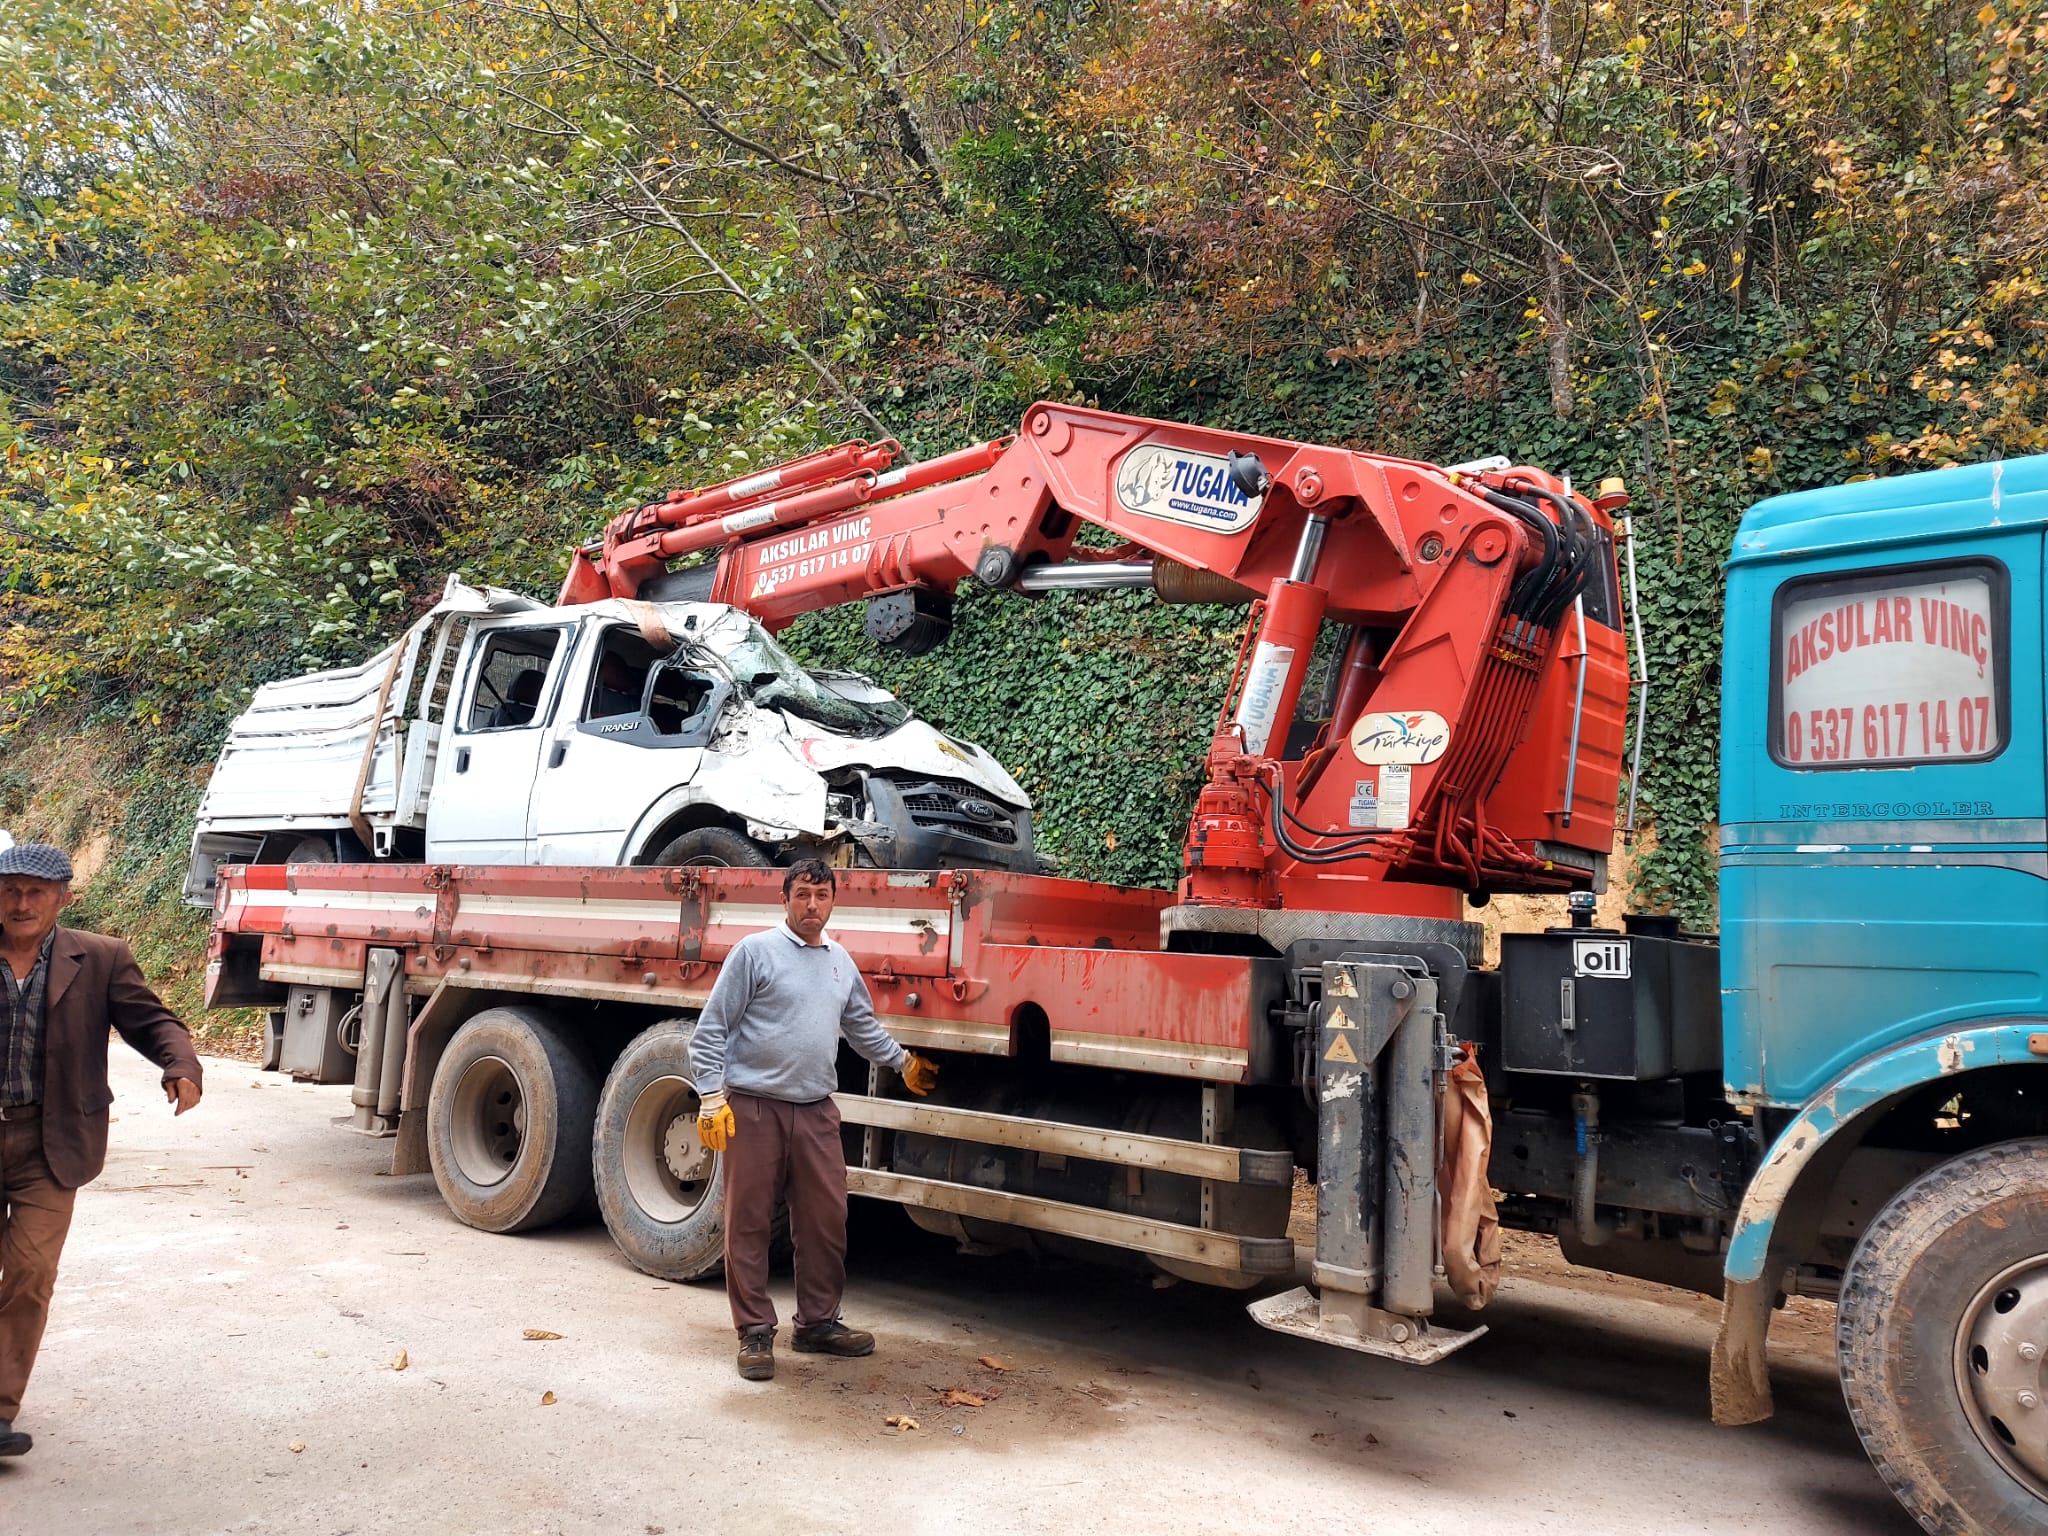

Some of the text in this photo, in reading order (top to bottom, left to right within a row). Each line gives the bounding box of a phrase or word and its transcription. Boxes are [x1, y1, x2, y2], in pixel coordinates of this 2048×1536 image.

[1171, 500, 1236, 521] www.tugana.com
[759, 517, 872, 566] AKSULAR VİNÇ
[759, 542, 871, 588] 0 537 617 14 07
[1786, 595, 1913, 685] AKSULAR
[600, 721, 641, 734] TRANSIT
[1788, 696, 1990, 761] 0 537 617 14 07
[1358, 730, 1443, 762] Türkiye
[1358, 785, 1372, 796] CE
[1780, 801, 1994, 819] INTERCOOLER
[1584, 946, 1621, 971] oil
